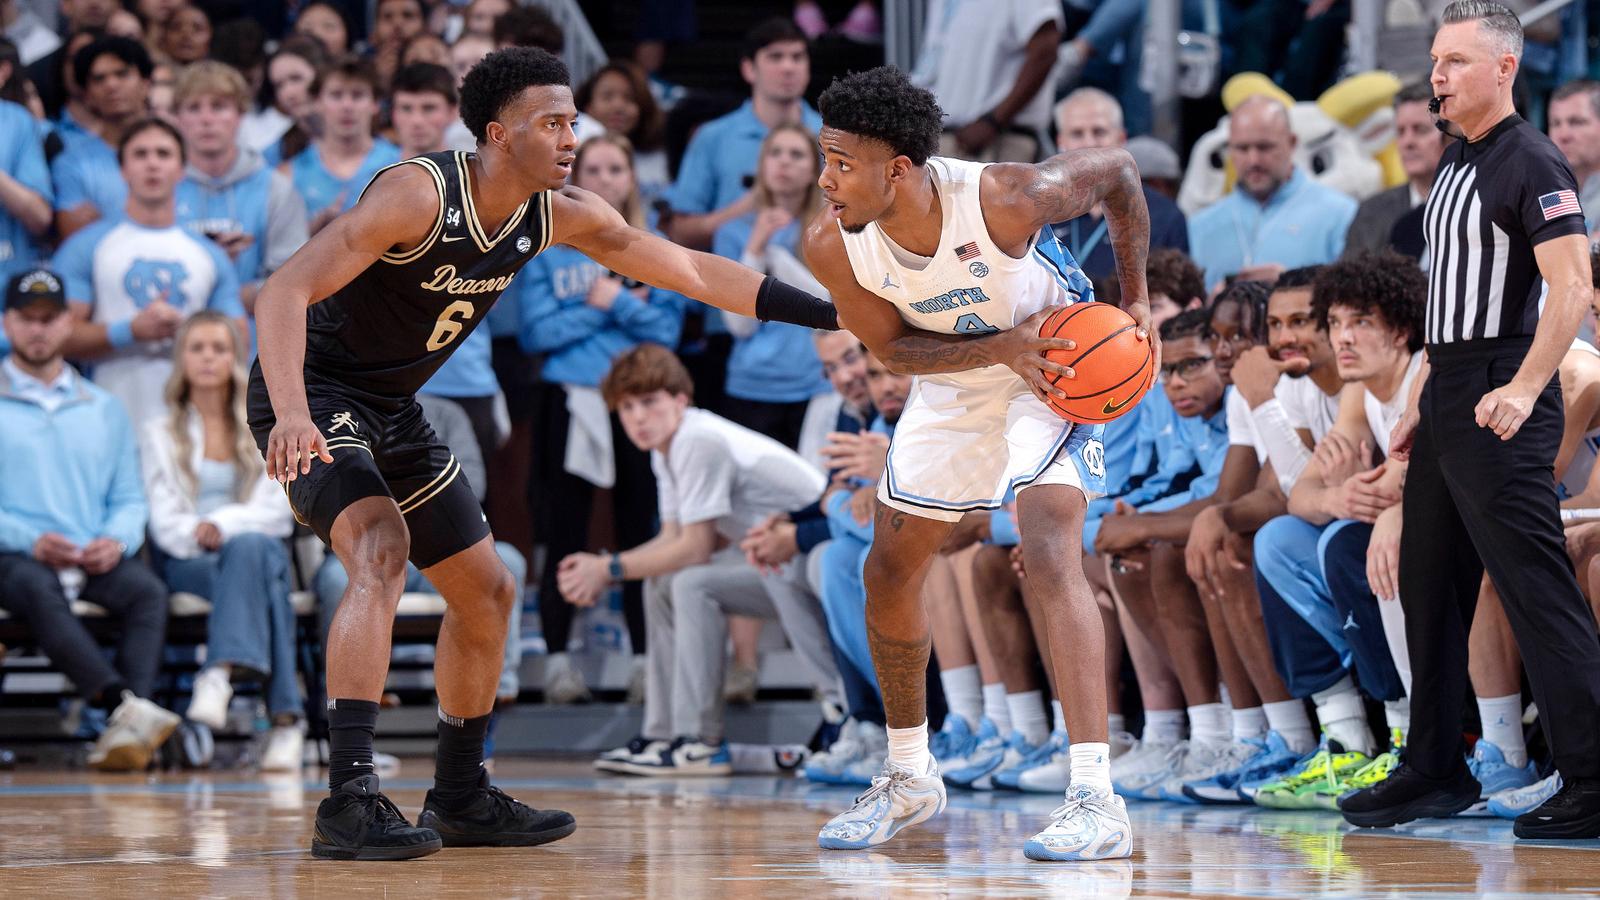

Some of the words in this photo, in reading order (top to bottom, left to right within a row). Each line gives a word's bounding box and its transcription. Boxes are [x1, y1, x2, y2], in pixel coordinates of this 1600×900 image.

[446, 207, 461, 227] 54
[421, 264, 515, 295] Deacons
[908, 286, 991, 315] NORTH
[426, 299, 475, 352] 6
